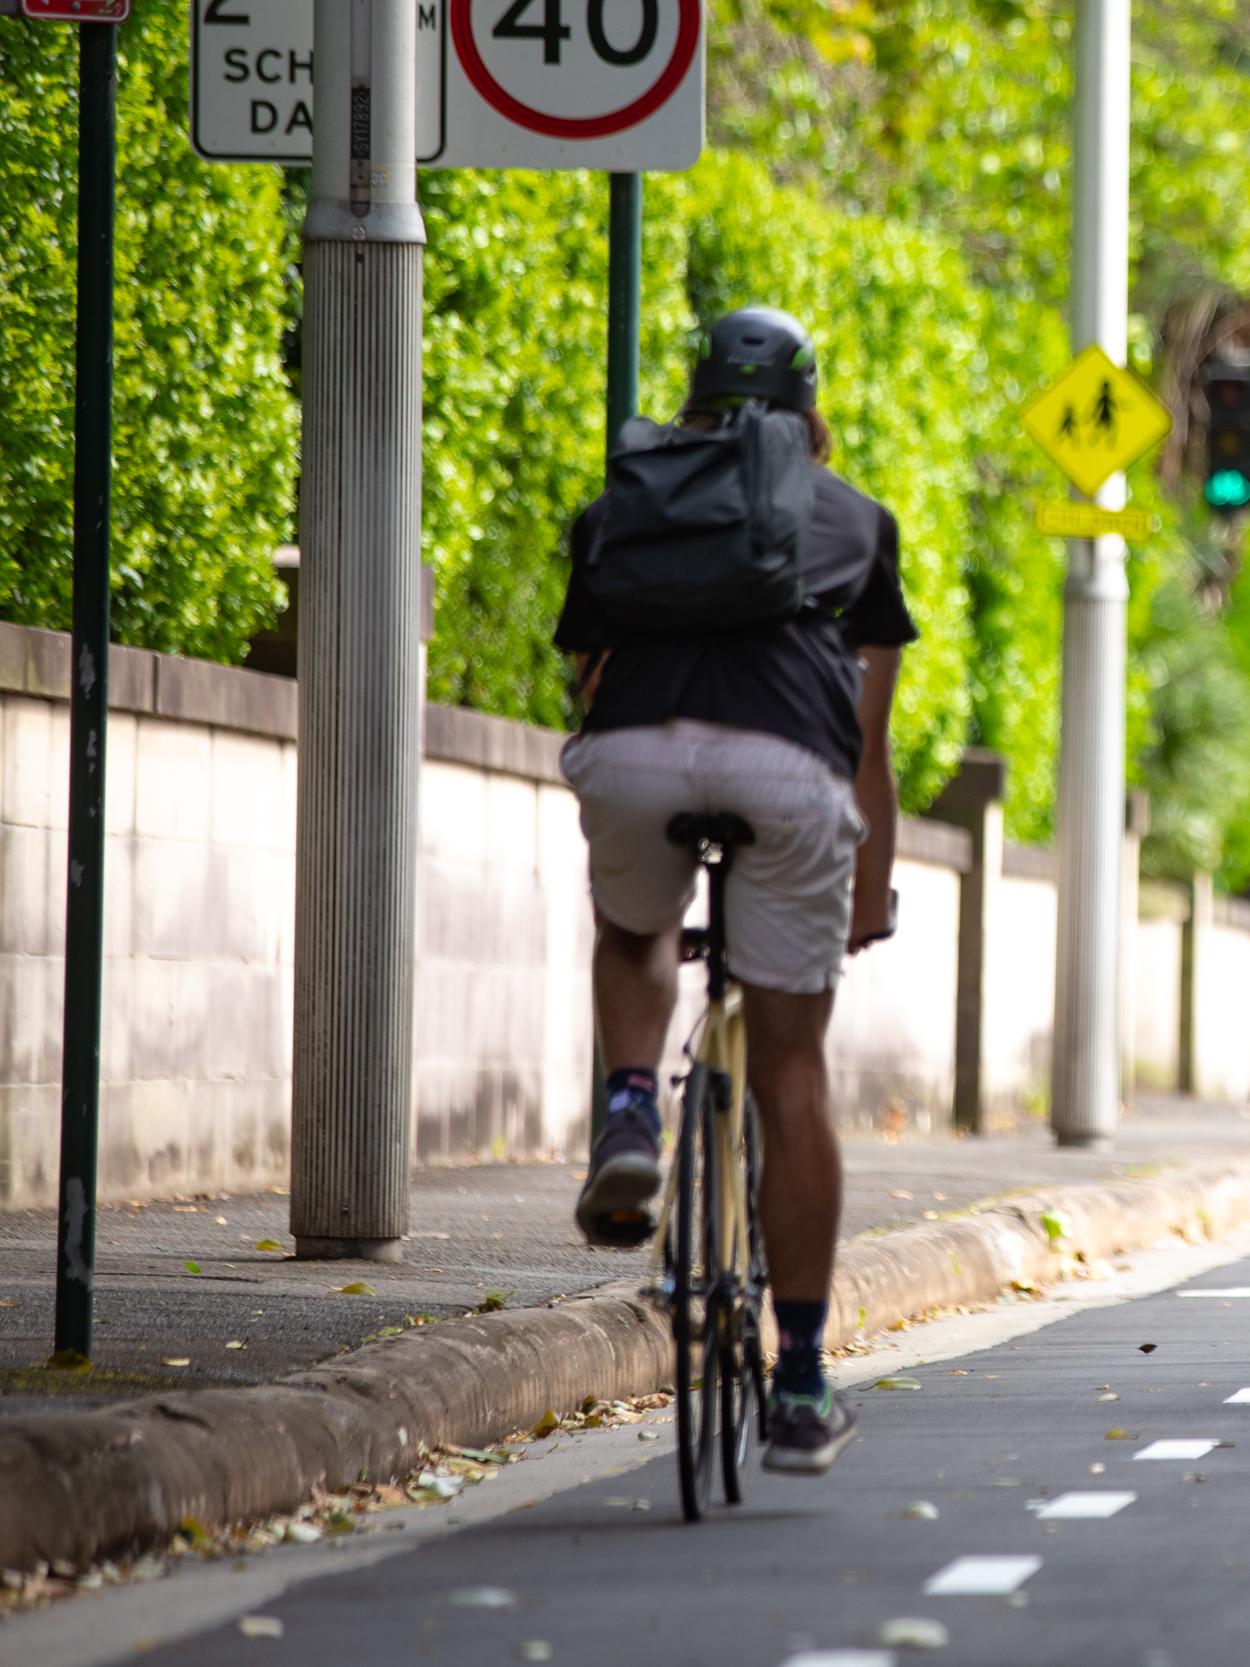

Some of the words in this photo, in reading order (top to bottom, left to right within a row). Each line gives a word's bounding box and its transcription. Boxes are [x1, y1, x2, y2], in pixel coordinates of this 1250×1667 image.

[417, 4, 437, 31] M
[491, 0, 660, 66] 40
[223, 48, 313, 84] SCH
[251, 100, 313, 135] DA
[352, 94, 370, 152] SY17892
